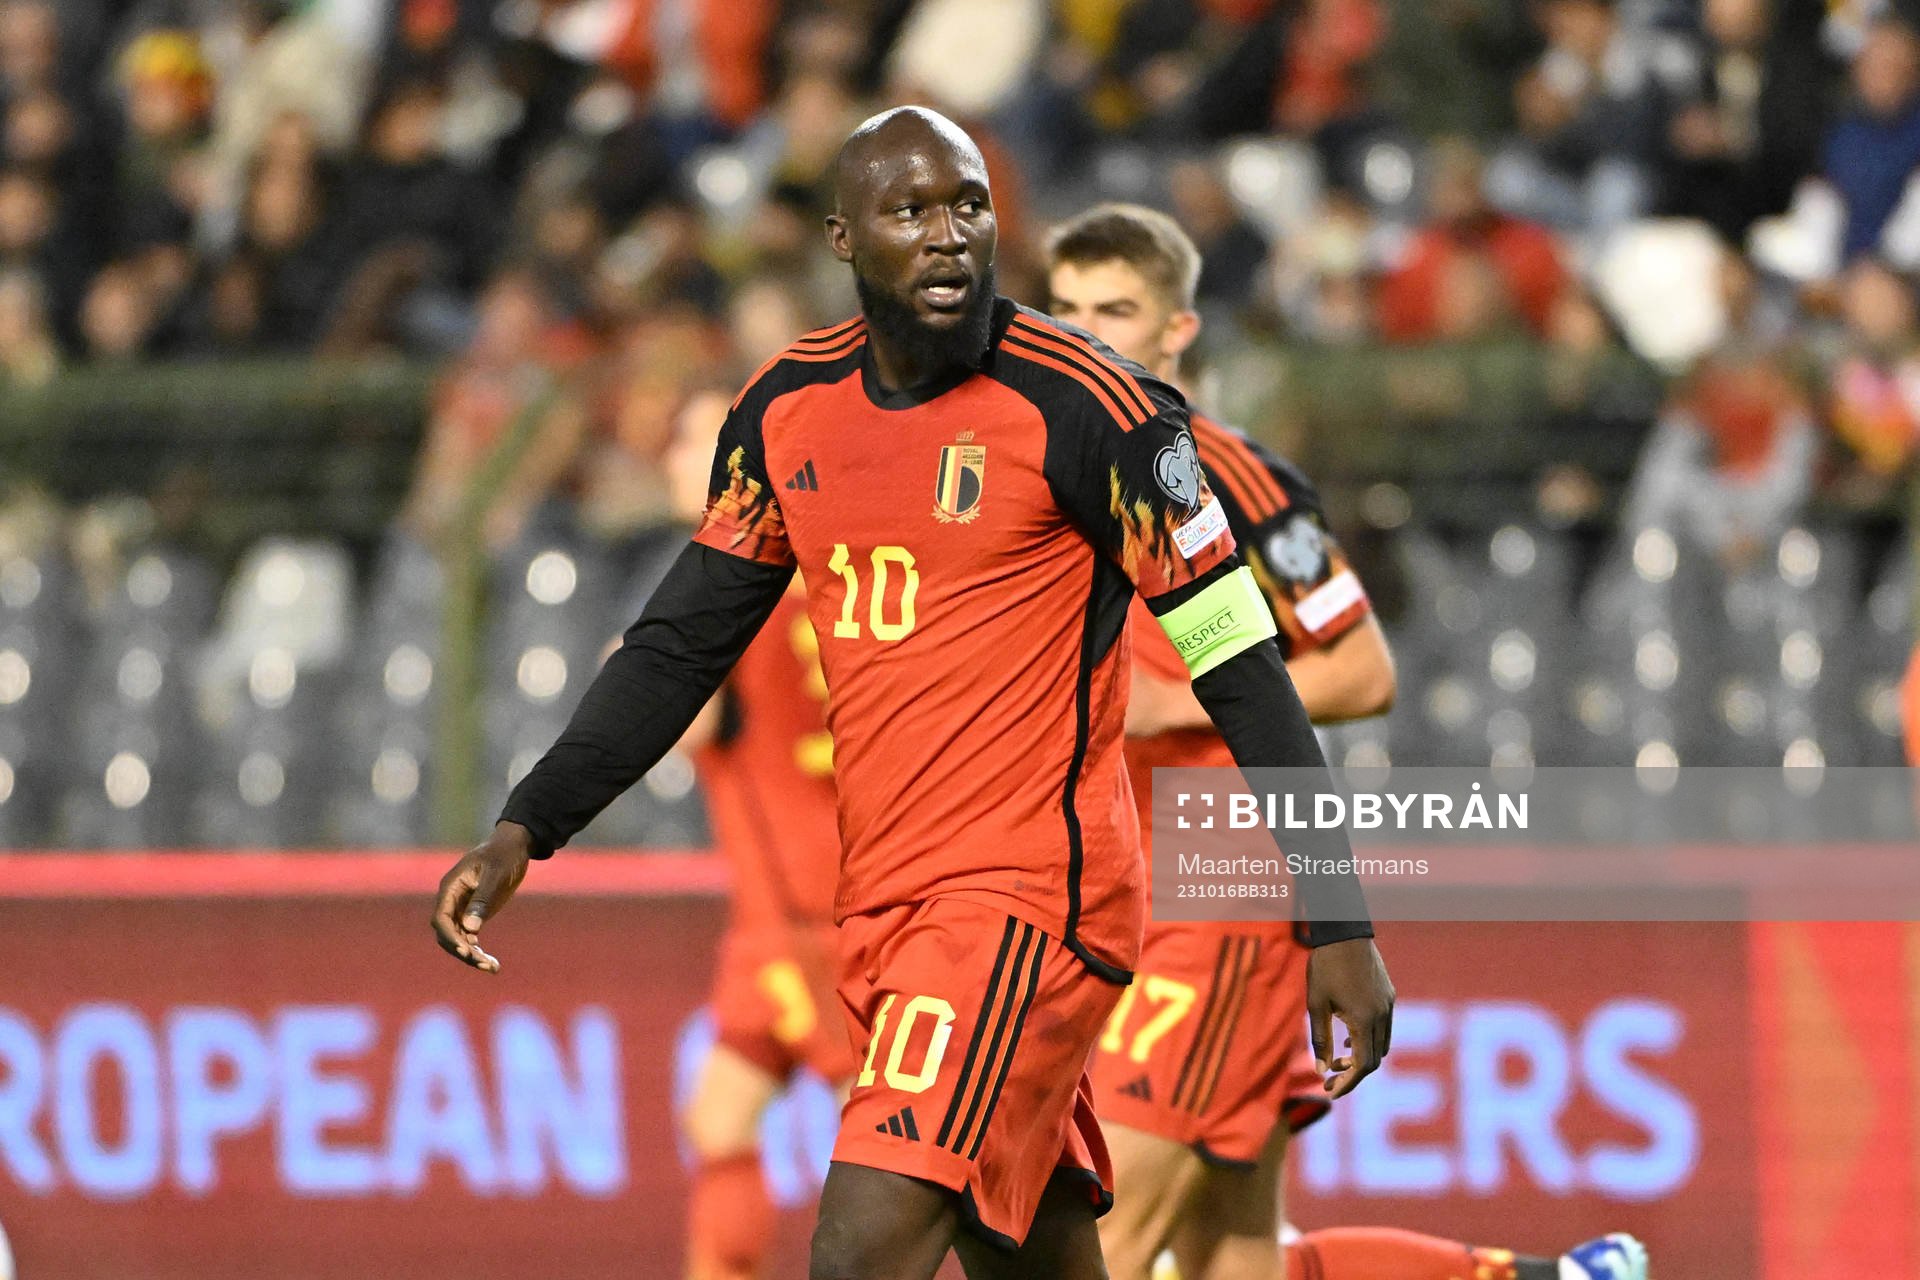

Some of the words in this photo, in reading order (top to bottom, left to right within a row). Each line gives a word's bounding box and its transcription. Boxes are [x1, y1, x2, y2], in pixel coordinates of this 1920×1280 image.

[828, 544, 920, 641] 10
[1177, 610, 1236, 654] RESPECT
[856, 994, 957, 1094] 10
[1101, 969, 1196, 1064] 17
